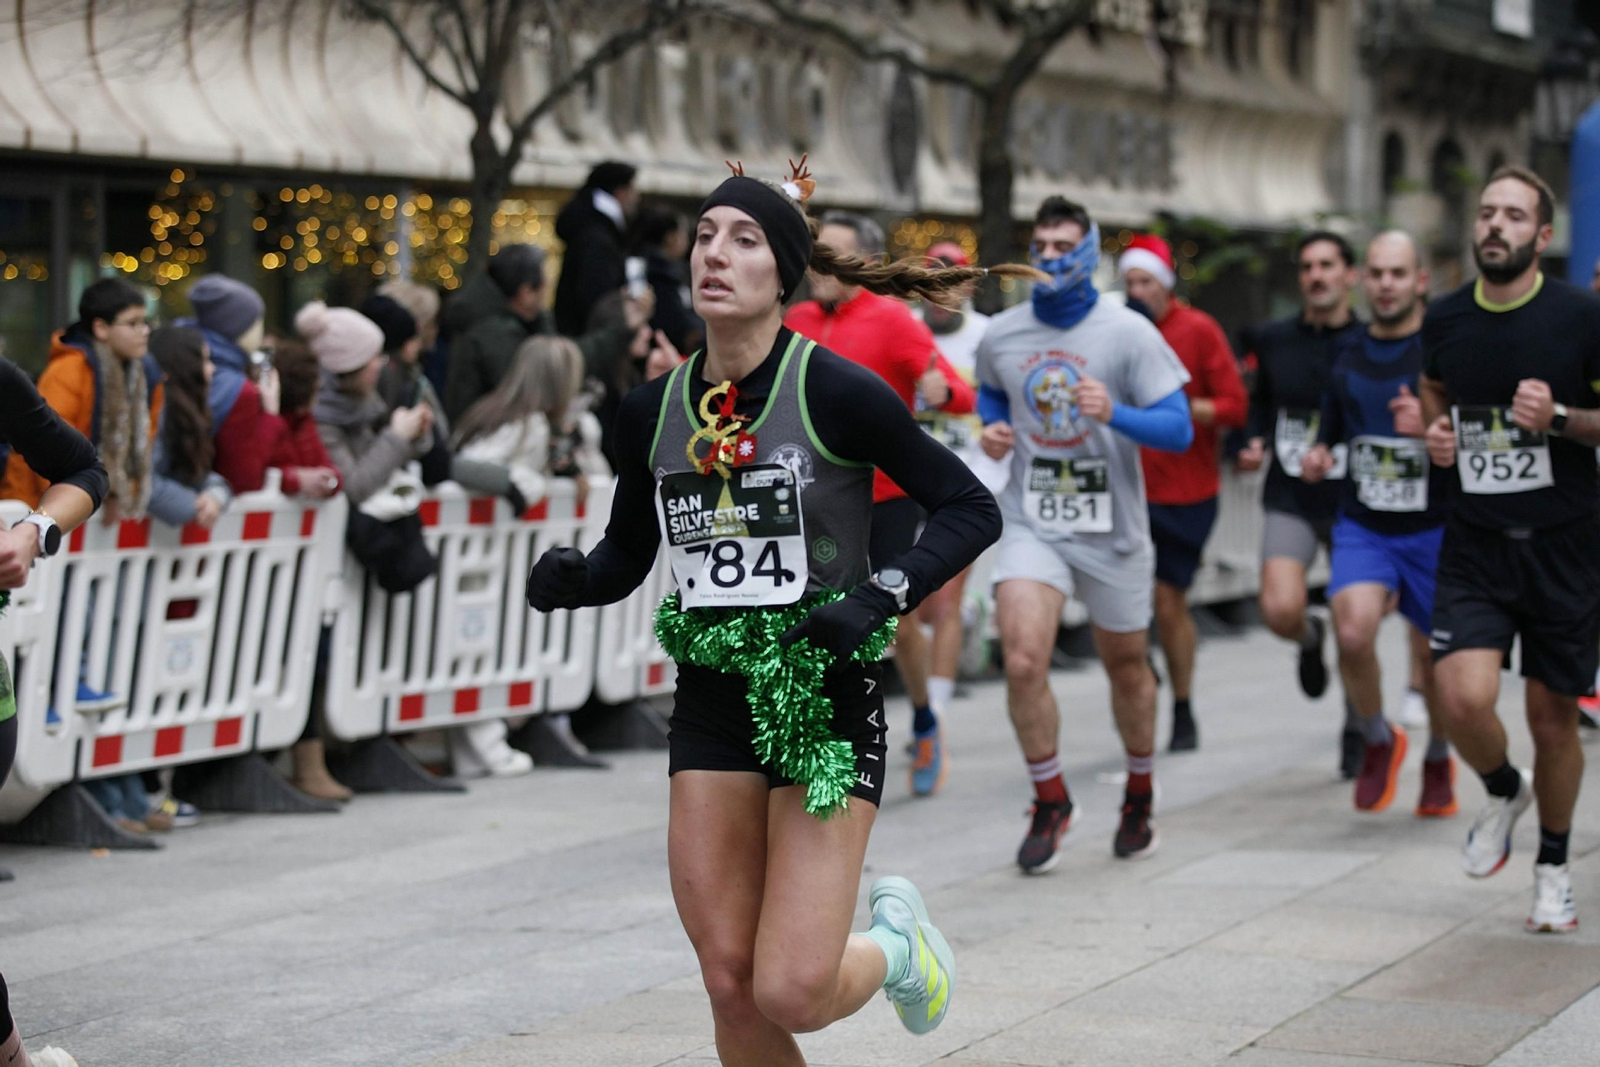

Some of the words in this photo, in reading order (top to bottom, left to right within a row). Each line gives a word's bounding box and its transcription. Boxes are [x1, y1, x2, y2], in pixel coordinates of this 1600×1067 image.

[1469, 452, 1538, 480] 952
[667, 494, 702, 516] SAN
[669, 503, 760, 534] SILVESTRE
[1039, 495, 1097, 521] 851
[684, 540, 785, 588] 784
[860, 709, 880, 788] FILA
